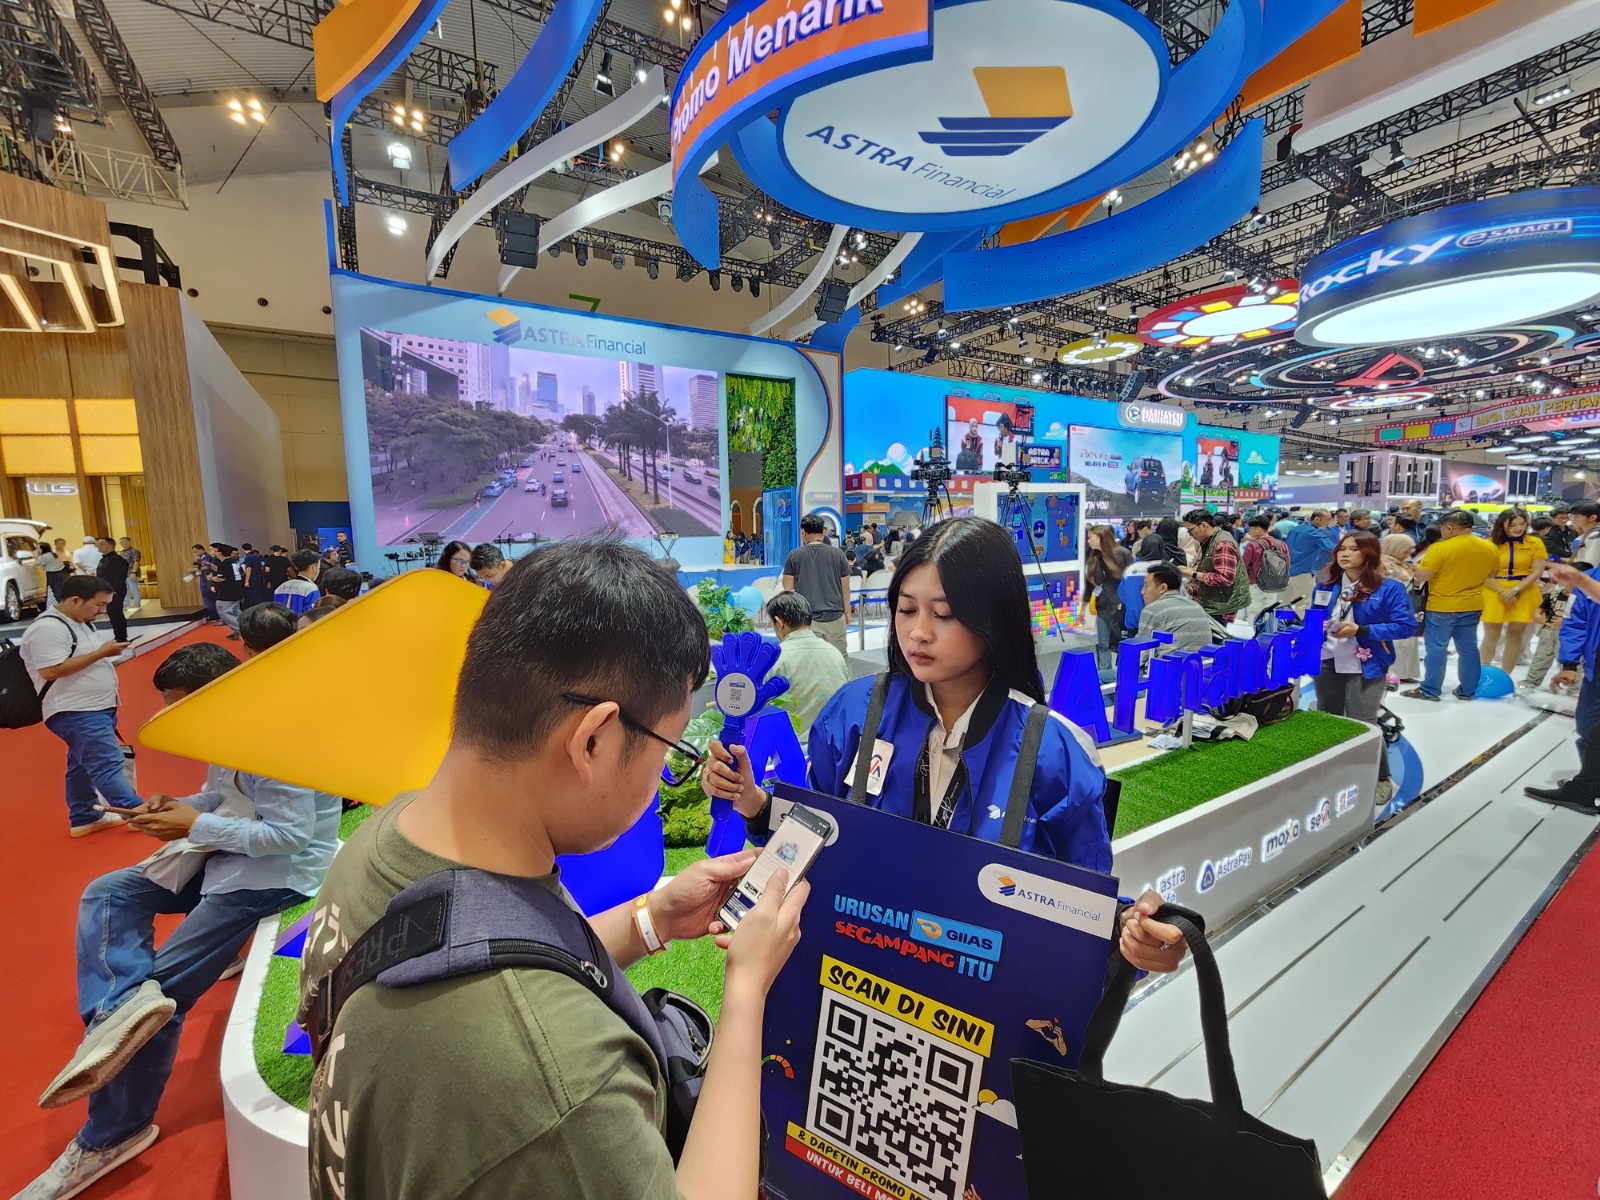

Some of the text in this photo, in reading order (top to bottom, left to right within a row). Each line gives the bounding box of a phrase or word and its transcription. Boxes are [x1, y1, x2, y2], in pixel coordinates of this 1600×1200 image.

[673, 65, 720, 146] Promo
[805, 124, 1015, 200] ASTRA Financial
[523, 326, 646, 355] ASTRA Financial
[1142, 407, 1183, 426] DAIHATSU
[1505, 404, 1540, 420] SEJAK
[1028, 447, 1050, 457] ASTRA
[1266, 824, 1299, 853] moxa
[1160, 869, 1186, 893] astra
[1217, 851, 1252, 878] AstraPay
[1017, 889, 1101, 922] ASTRA Financial
[834, 894, 993, 951] URUSAN GIIAS
[835, 921, 994, 982] SEGAMPANG ITU
[828, 965, 986, 1047] SCAN DI SINI
[797, 1130, 806, 1142] &
[810, 1136, 860, 1172] DAPETIN
[862, 1167, 906, 1198] PROMO
[806, 1150, 844, 1179] UNTUK
[846, 1173, 873, 1196] BELI
